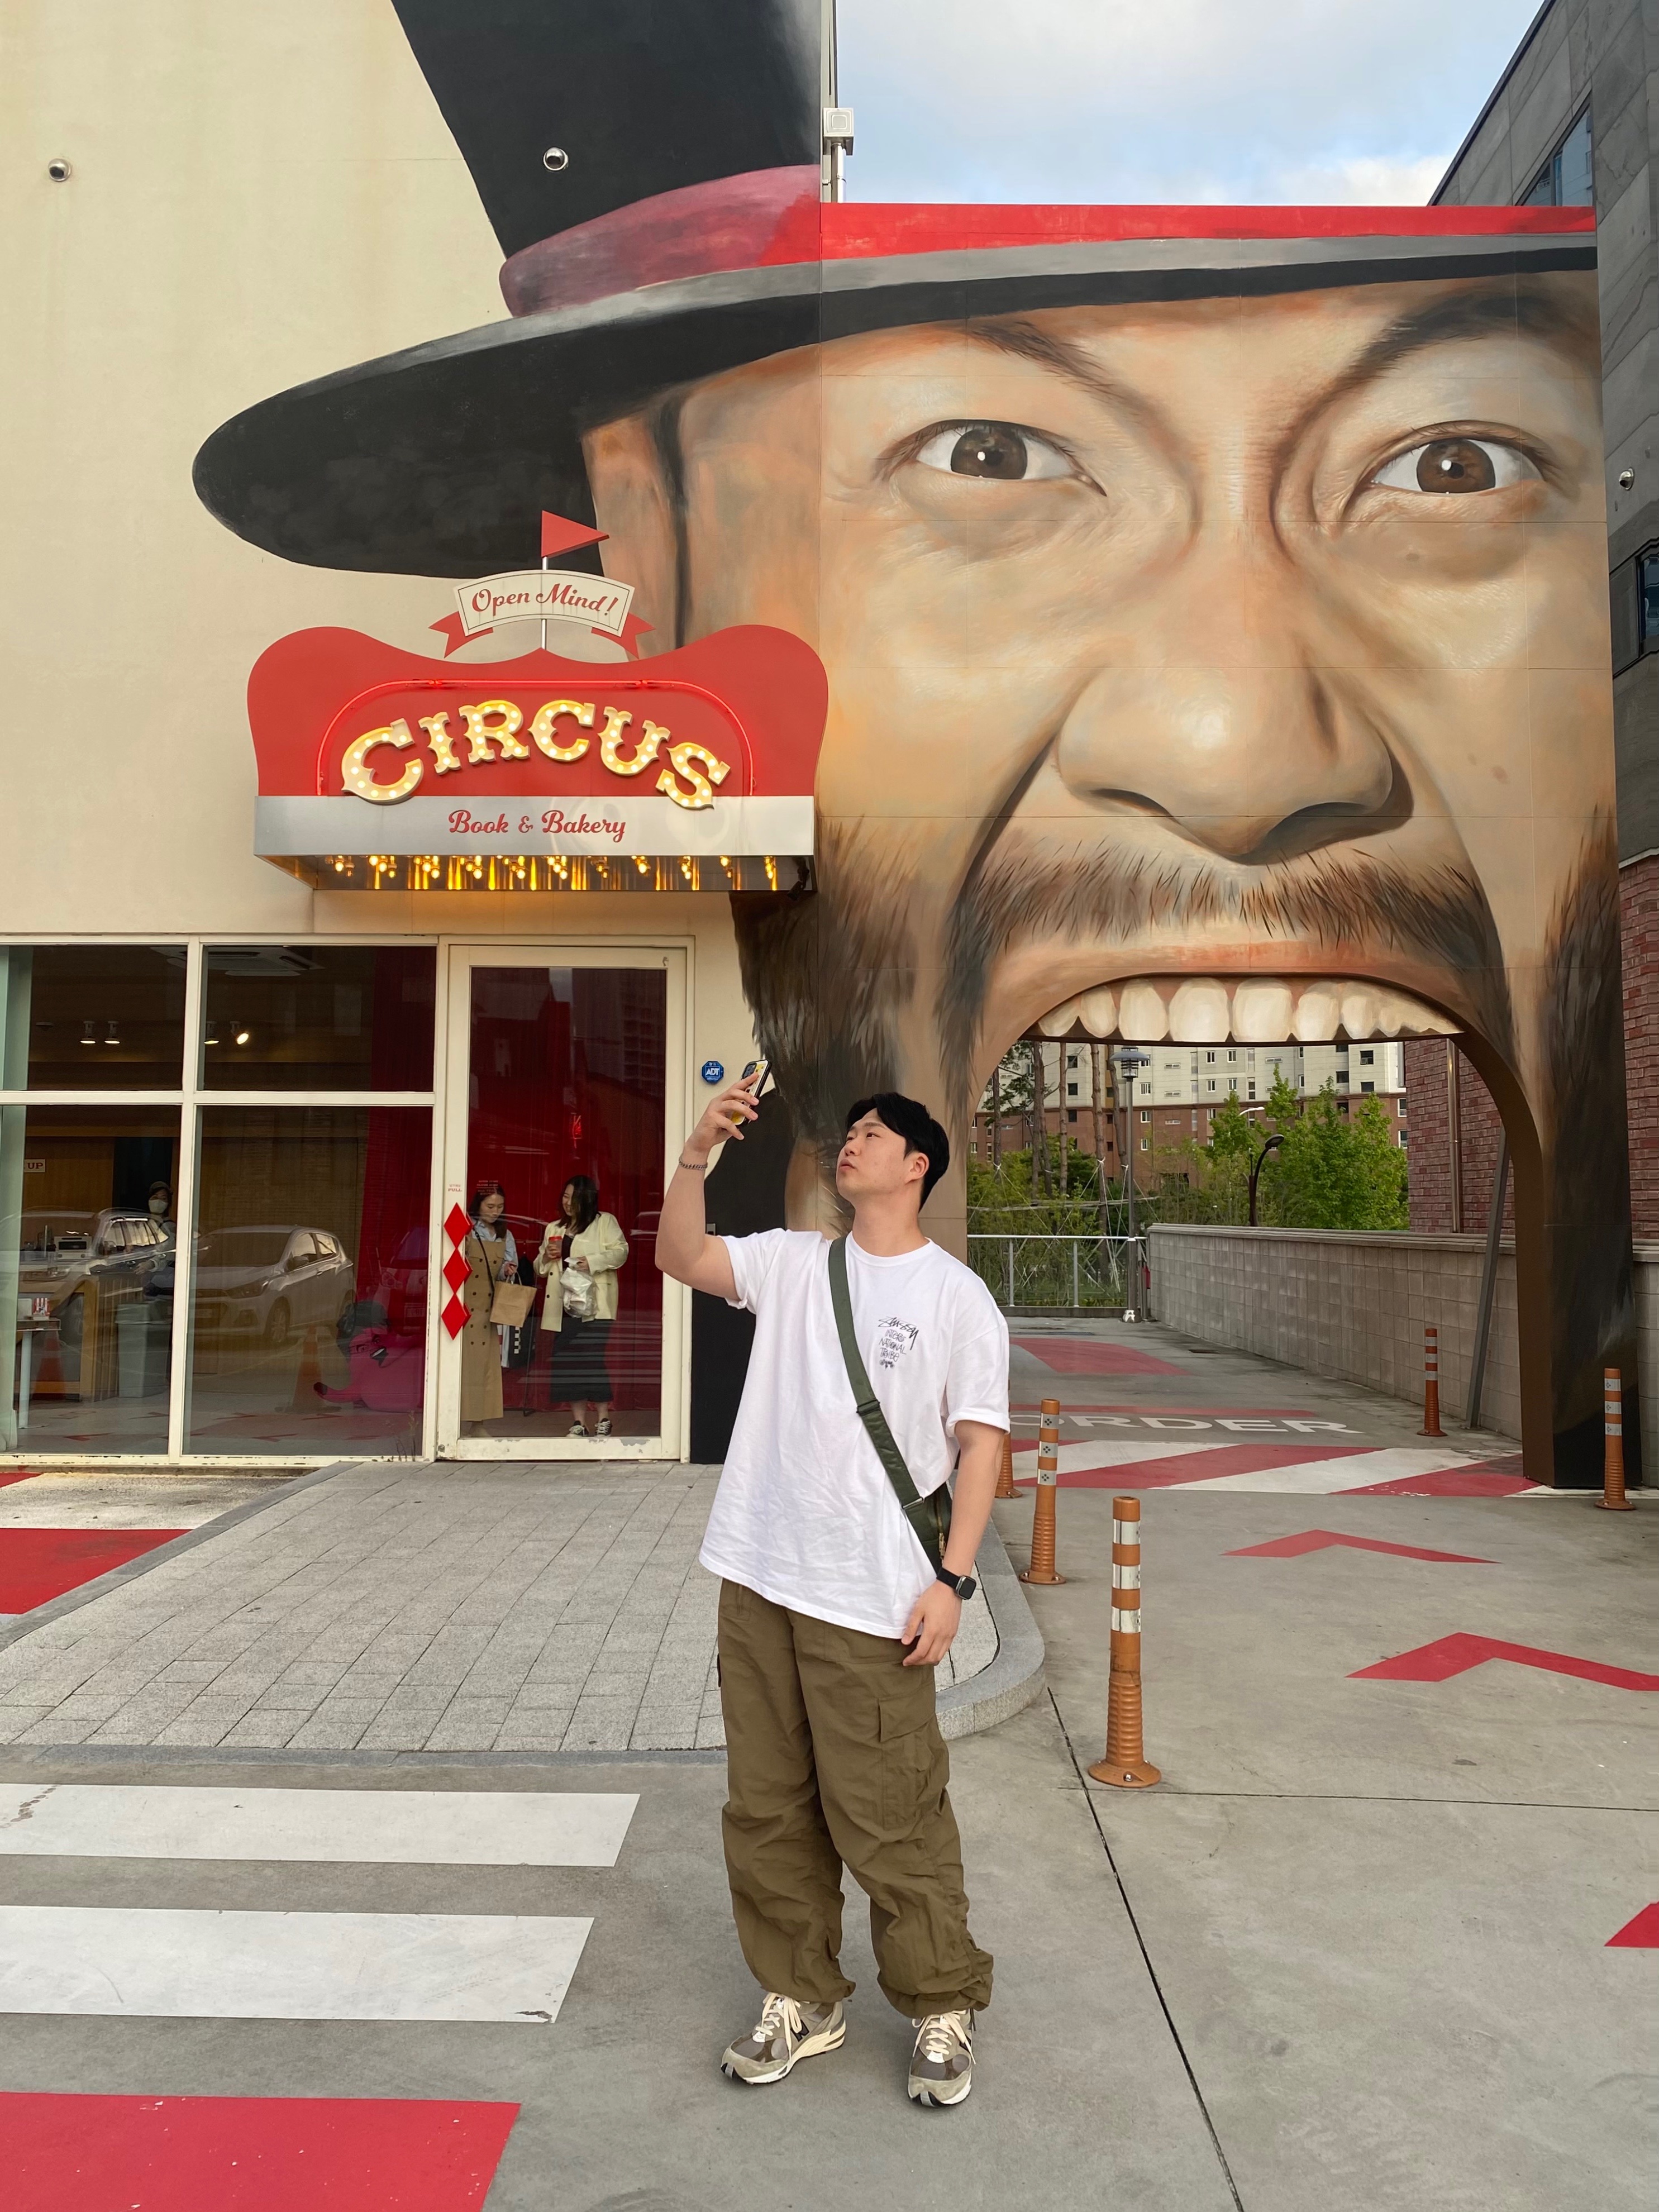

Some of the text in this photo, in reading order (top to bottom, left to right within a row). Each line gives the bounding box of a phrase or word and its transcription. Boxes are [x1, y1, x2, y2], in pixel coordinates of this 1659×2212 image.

[472, 583, 618, 616] Open Mind!
[341, 699, 731, 809] CIRCUS
[449, 810, 626, 843] Book & Bakery
